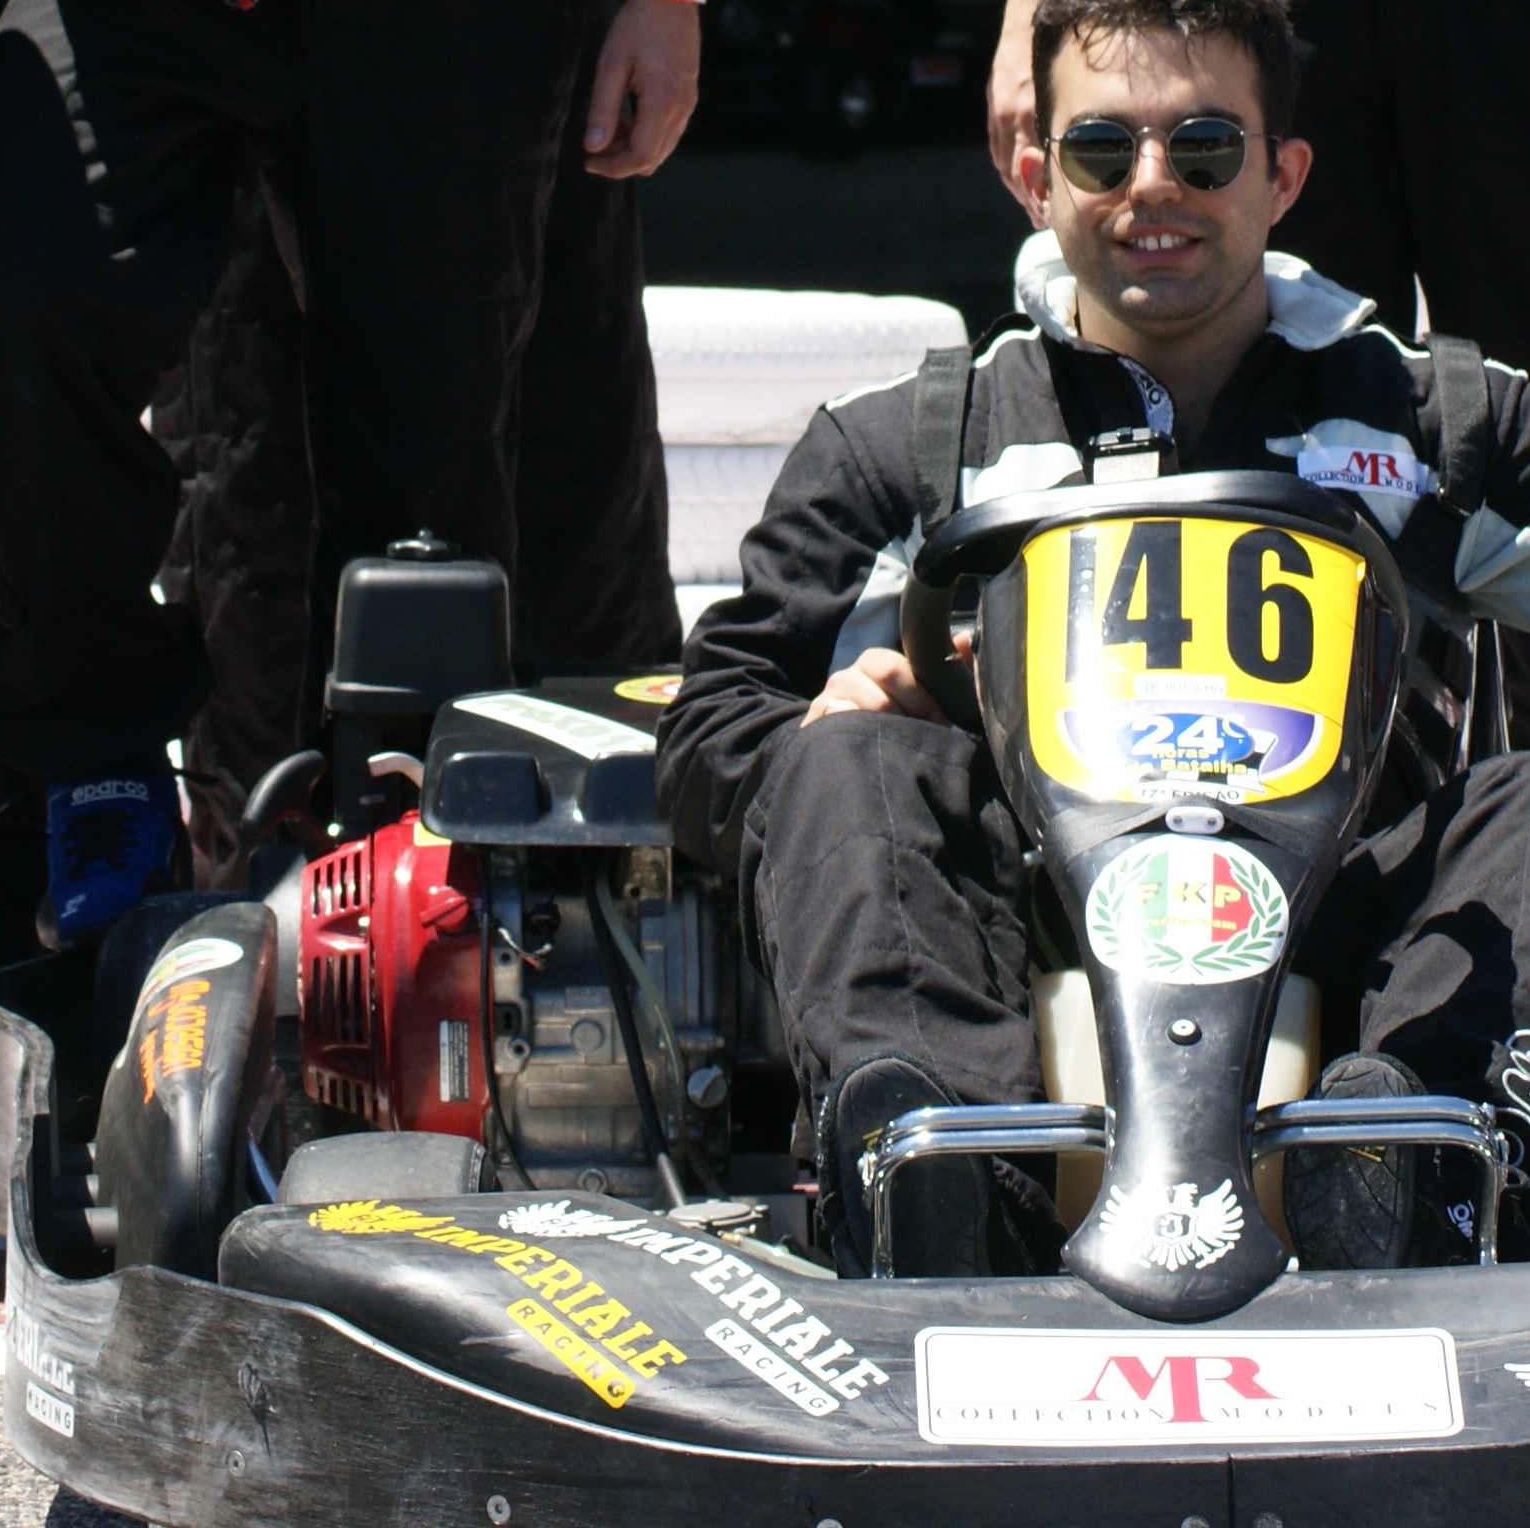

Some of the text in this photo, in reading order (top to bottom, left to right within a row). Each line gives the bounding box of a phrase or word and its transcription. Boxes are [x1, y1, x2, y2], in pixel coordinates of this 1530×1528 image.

[1342, 450, 1403, 486] MR
[1130, 715, 1225, 756] 24
[1151, 748, 1210, 759] horas
[1160, 759, 1248, 774] Batalha
[1134, 881, 1242, 909] FKP
[413, 1225, 687, 1379] IMPERIALE
[607, 1227, 889, 1401] IMPERIALE
[515, 1304, 627, 1400] RACING
[715, 1326, 828, 1410] RACING
[1070, 1355, 1288, 1423] MR
[28, 1390, 72, 1430] RACING
[935, 1400, 1439, 1423] COLLECTION MODELS
